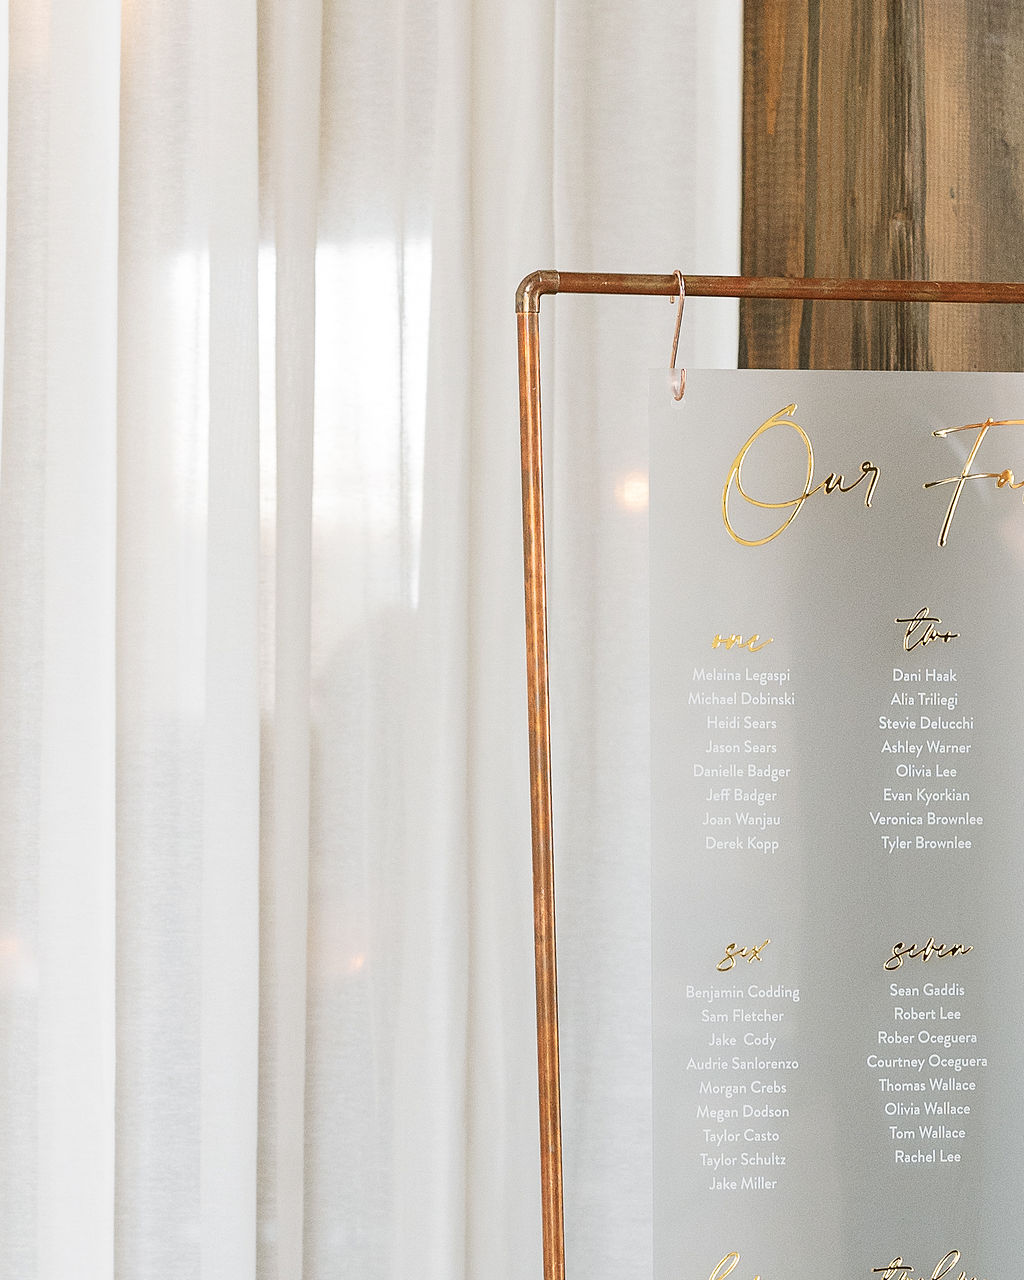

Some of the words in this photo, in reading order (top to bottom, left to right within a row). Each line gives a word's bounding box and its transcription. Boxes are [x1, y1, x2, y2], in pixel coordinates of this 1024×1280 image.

[722, 403, 881, 547] Our
[894, 606, 961, 653] two
[711, 630, 774, 653] one
[692, 667, 742, 681] Melaina
[745, 667, 791, 686] Legaspi
[892, 667, 922, 682] Dani
[925, 668, 957, 682] Haak
[688, 692, 737, 705] Michael
[741, 691, 795, 706] Dobinski
[890, 692, 915, 706] Alia
[917, 692, 958, 711] Triliegi
[707, 715, 740, 729] Heidi
[743, 715, 778, 730] Sears
[878, 715, 917, 730] Stevie
[920, 715, 974, 730] Delucchi
[880, 739, 924, 758] Ashley
[926, 740, 972, 754] Warner
[693, 763, 744, 778] Danielle
[747, 763, 792, 783] Badger
[895, 763, 932, 778] Olivia
[935, 763, 958, 778] Lee
[883, 787, 913, 802] Evan
[916, 787, 970, 807] Kyorkian
[702, 812, 732, 826] Joan
[734, 812, 781, 831] Wanjau
[869, 811, 923, 826] Veronica
[927, 811, 984, 826] Brownlee
[705, 836, 744, 850] Derek
[747, 836, 780, 855] Kopp
[715, 938, 771, 972] six
[883, 937, 974, 971] seven
[686, 985, 744, 1004] Benjamin
[747, 984, 801, 1003] Codding
[889, 982, 920, 997] Sean
[922, 982, 965, 997] Gaddis
[701, 1008, 729, 1023] Sam
[732, 1008, 785, 1022] Fletcher
[877, 1030, 915, 1044] Rober
[917, 1030, 978, 1049] Oceguera
[686, 1057, 729, 1070] Audrie
[731, 1056, 800, 1070] Sanlorenzo
[866, 1054, 926, 1073] Courtney
[928, 1053, 988, 1072] Oceguera
[699, 1081, 747, 1099] Morgan
[750, 1080, 787, 1094] Crebs
[878, 1078, 927, 1092] Thomas
[928, 1077, 976, 1091] Wallace
[696, 1105, 739, 1123] Megan
[742, 1104, 790, 1118] Dodson
[884, 1102, 921, 1116] Olivia
[923, 1101, 971, 1115] Wallace
[888, 1125, 916, 1140] Tom
[918, 1125, 966, 1139] Wallace
[699, 1152, 738, 1171] Taylor
[740, 1151, 787, 1166] Schultz
[894, 1149, 936, 1164] Rachel
[939, 1149, 961, 1163] Lee
